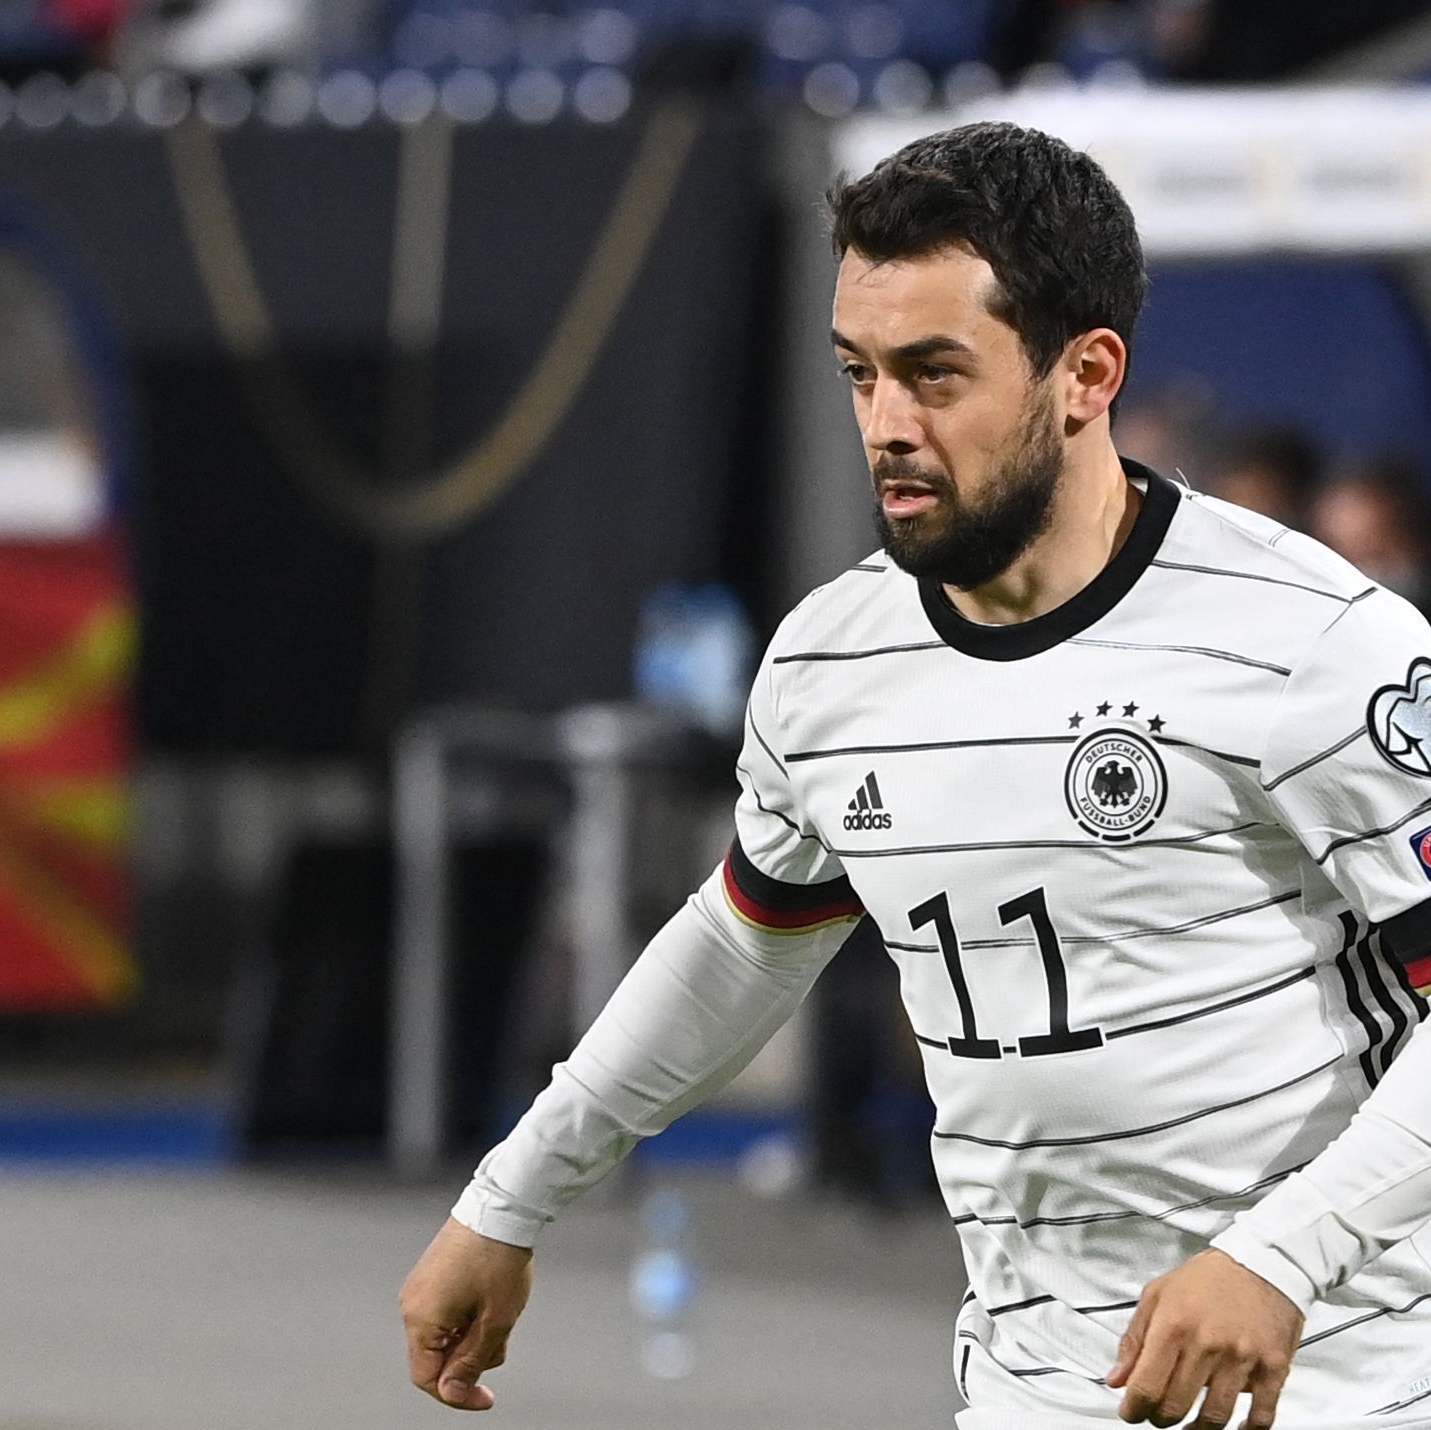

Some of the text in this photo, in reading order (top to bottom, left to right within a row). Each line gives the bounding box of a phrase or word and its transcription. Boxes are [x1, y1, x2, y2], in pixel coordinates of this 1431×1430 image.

[1085, 742, 1143, 763] DEUTSCHER
[843, 809, 892, 831] adidas
[1080, 795, 1151, 826] FUSSBALL-BUND
[908, 887, 1103, 1059] 11
